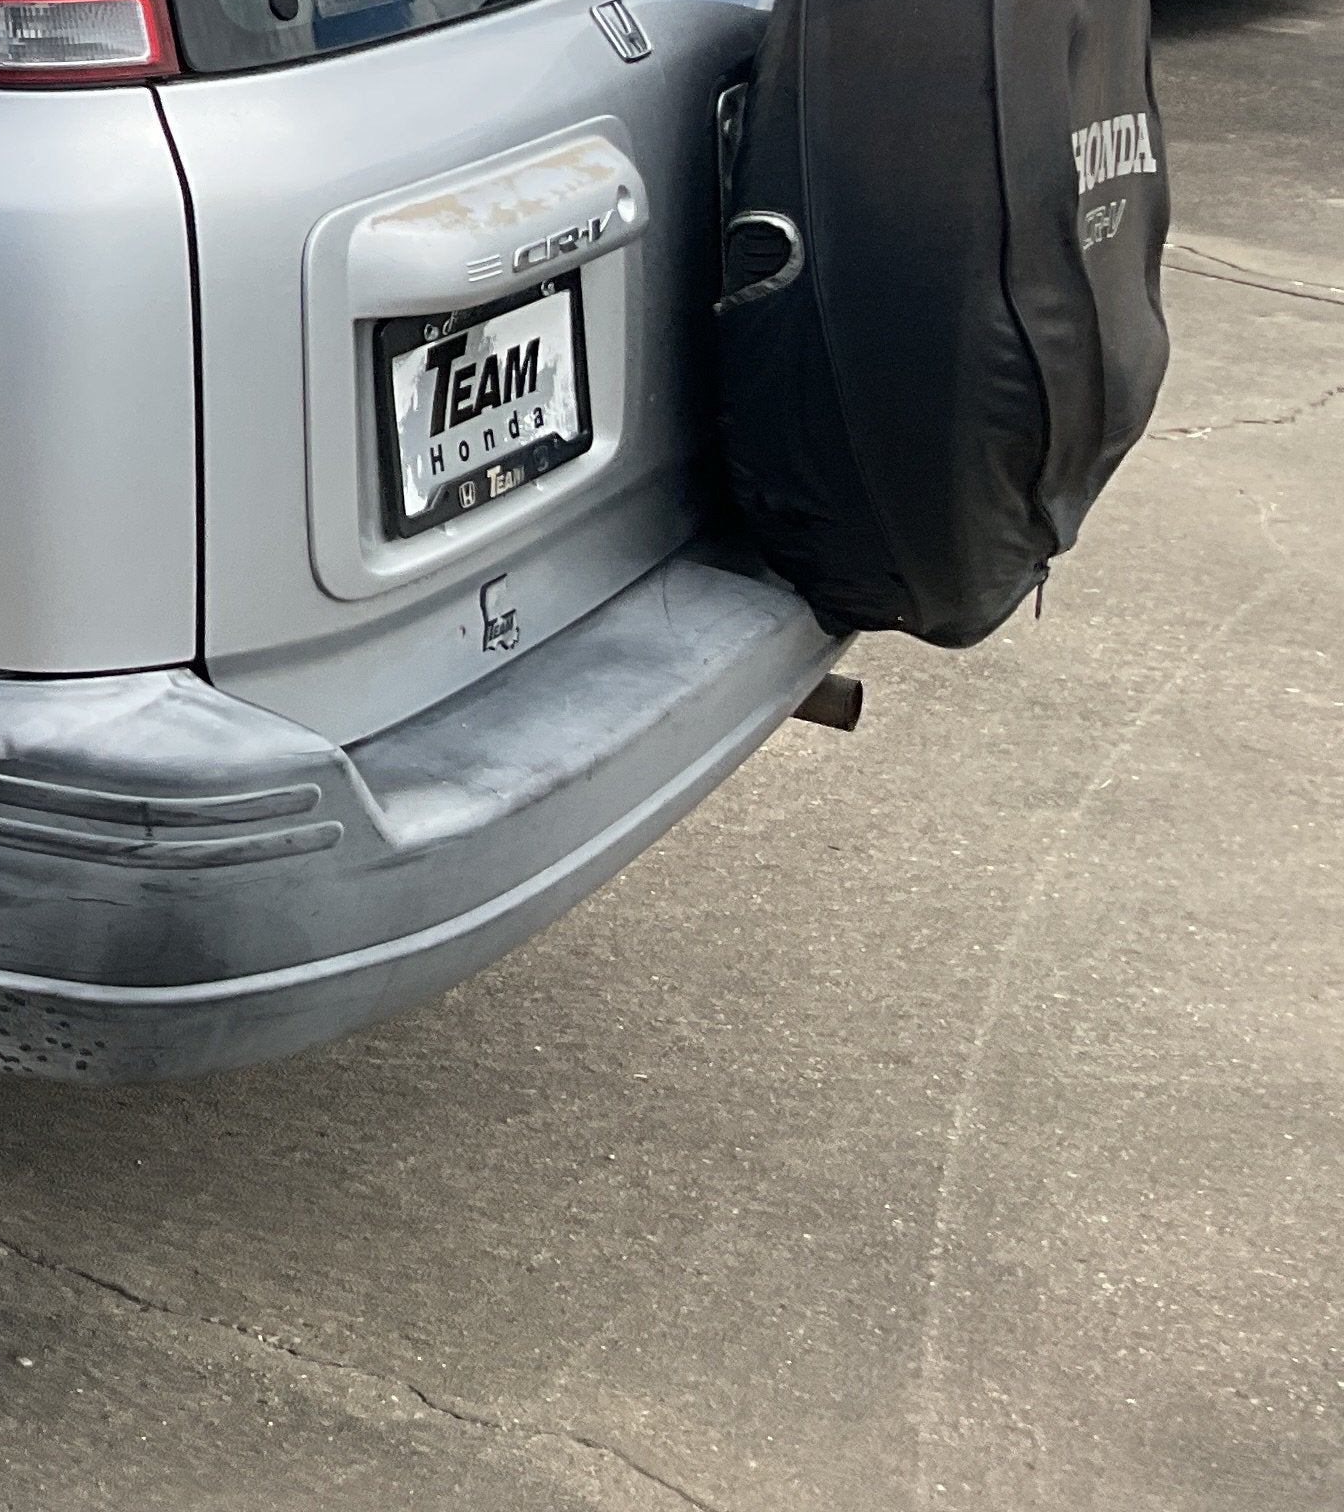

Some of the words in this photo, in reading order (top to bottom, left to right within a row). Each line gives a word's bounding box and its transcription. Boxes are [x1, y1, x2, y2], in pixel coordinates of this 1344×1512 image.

[1071, 112, 1157, 195] HONDA
[512, 209, 615, 273] CR-V
[425, 331, 541, 438] TEAM
[429, 406, 545, 475] Honda
[486, 464, 525, 498] TEAM
